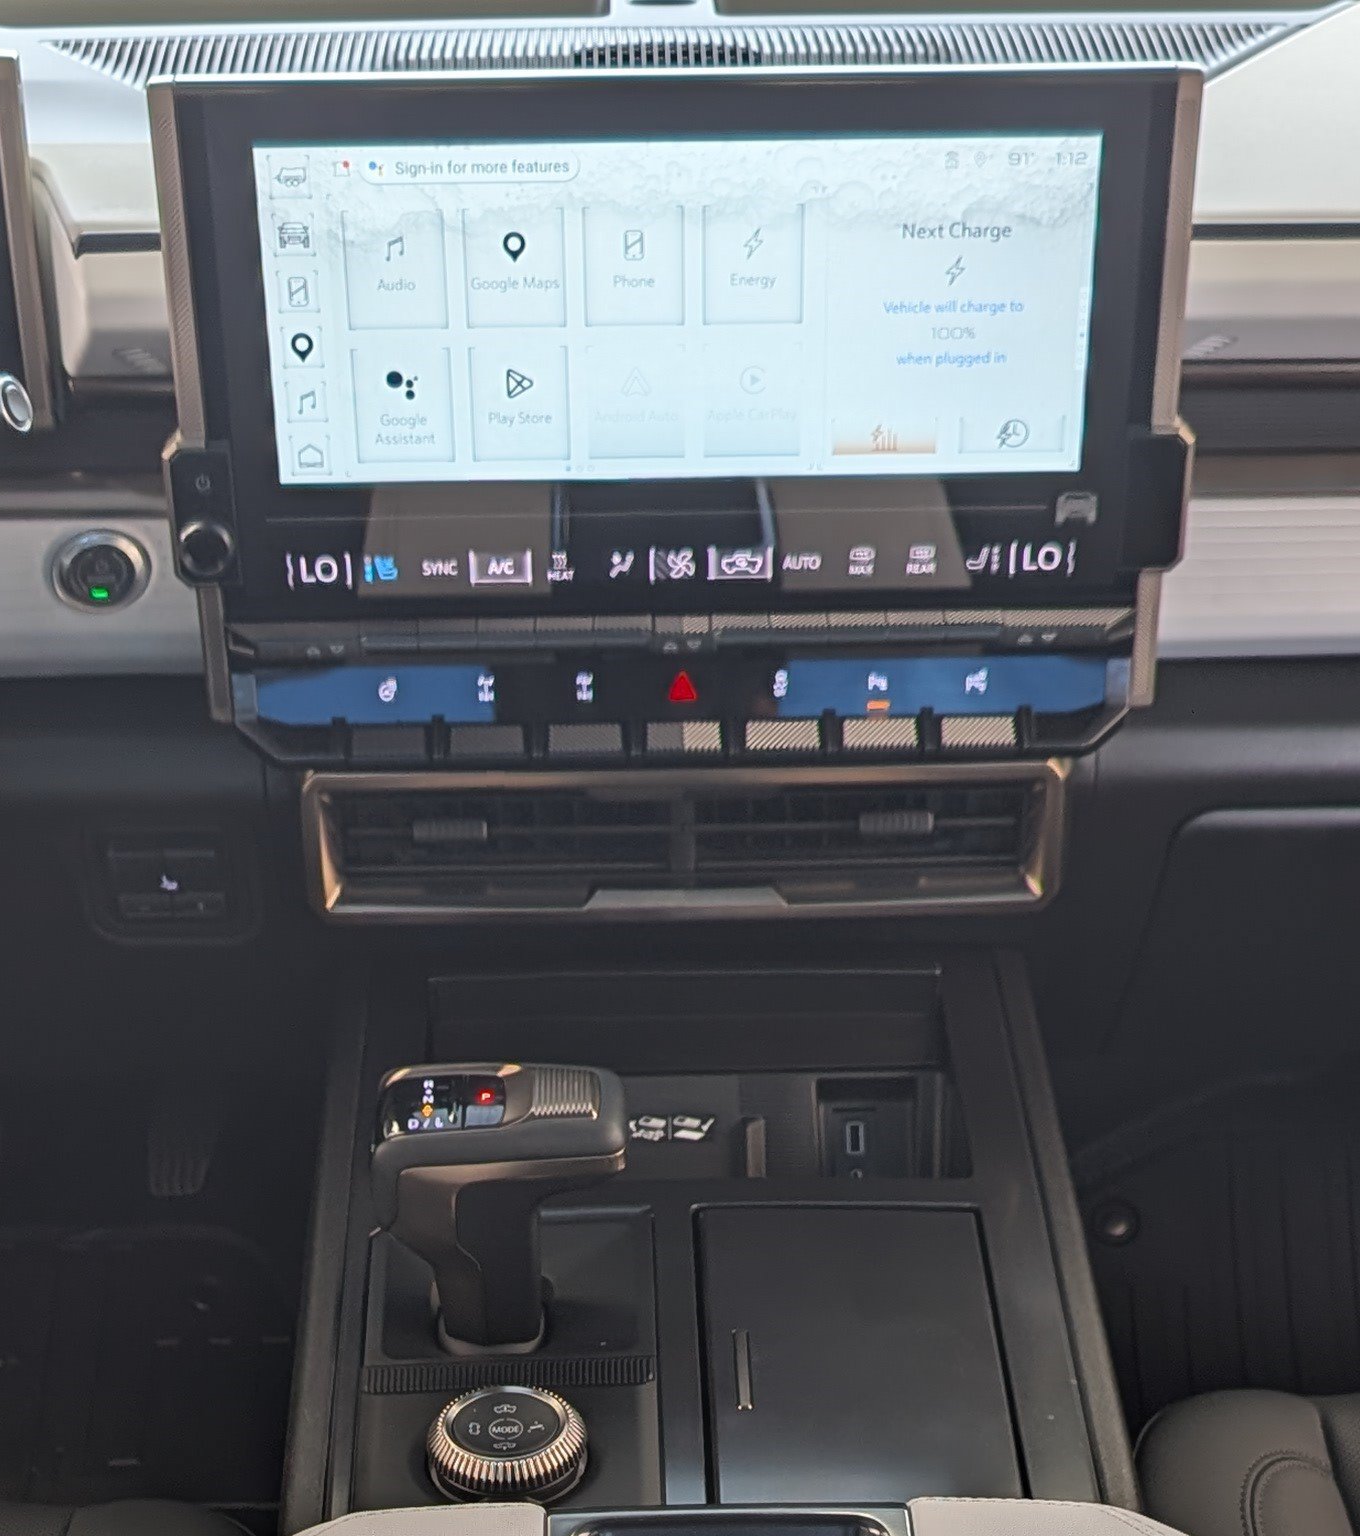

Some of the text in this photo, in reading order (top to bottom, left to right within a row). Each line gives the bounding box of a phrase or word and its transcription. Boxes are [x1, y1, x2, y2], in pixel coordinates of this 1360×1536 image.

[394, 159, 570, 177] Sign-in for more features
[901, 222, 1013, 242] Next Charge
[377, 278, 416, 291] Audio
[470, 276, 561, 293] Google Maps
[612, 275, 656, 288] Phone
[729, 273, 778, 289] Energy
[883, 301, 1024, 316] Vehicle will charge to
[931, 327, 976, 340] 100%
[896, 352, 1007, 367] when plugged in
[379, 414, 428, 429] Google
[488, 411, 552, 427] Play Store
[375, 433, 436, 446] Assistant
[782, 553, 822, 571] AUTO
[1022, 541, 1062, 571] LO
[299, 554, 338, 583] LO
[422, 559, 458, 576] SYNC
[488, 557, 515, 575] A/C
[491, 1425, 519, 1435] MODE
